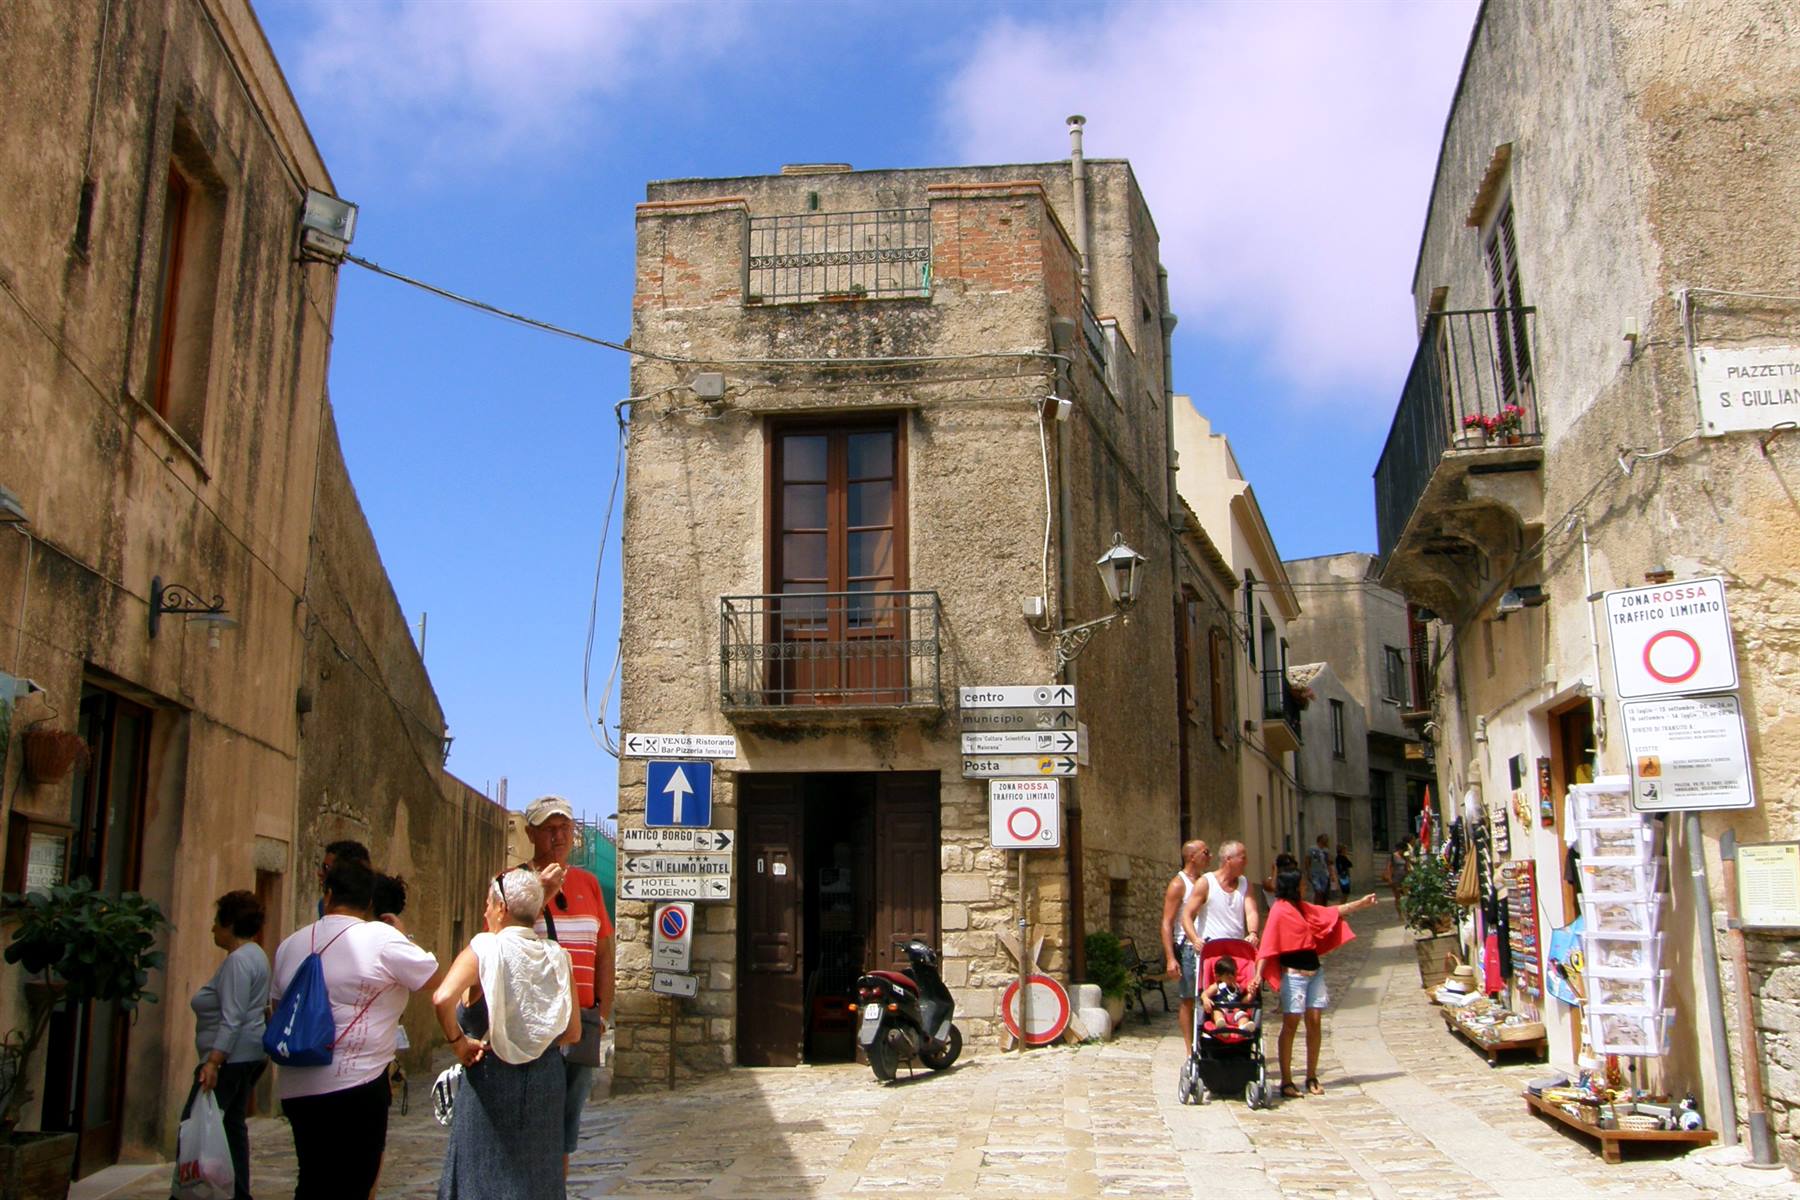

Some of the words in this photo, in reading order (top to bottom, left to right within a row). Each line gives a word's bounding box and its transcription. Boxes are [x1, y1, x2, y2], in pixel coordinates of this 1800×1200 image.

[1720, 391, 1731, 408] S
[1621, 594, 1650, 608] ZONA
[1652, 586, 1707, 604] ROSSA
[1613, 608, 1665, 625] TRAFFICO
[1670, 600, 1720, 618] LIMITATO
[964, 692, 1005, 702] centro
[962, 714, 1025, 724] municipio
[696, 738, 734, 746] Ristorante
[964, 761, 1000, 771] Posta
[1026, 792, 1055, 800] LIMITATO
[625, 830, 658, 840] ANTICO
[662, 830, 692, 840] BORGO
[666, 863, 696, 873] ELIMO
[700, 863, 730, 873] HOTEL
[641, 879, 677, 887] HOTEL
[641, 888, 697, 897] MODERNO
